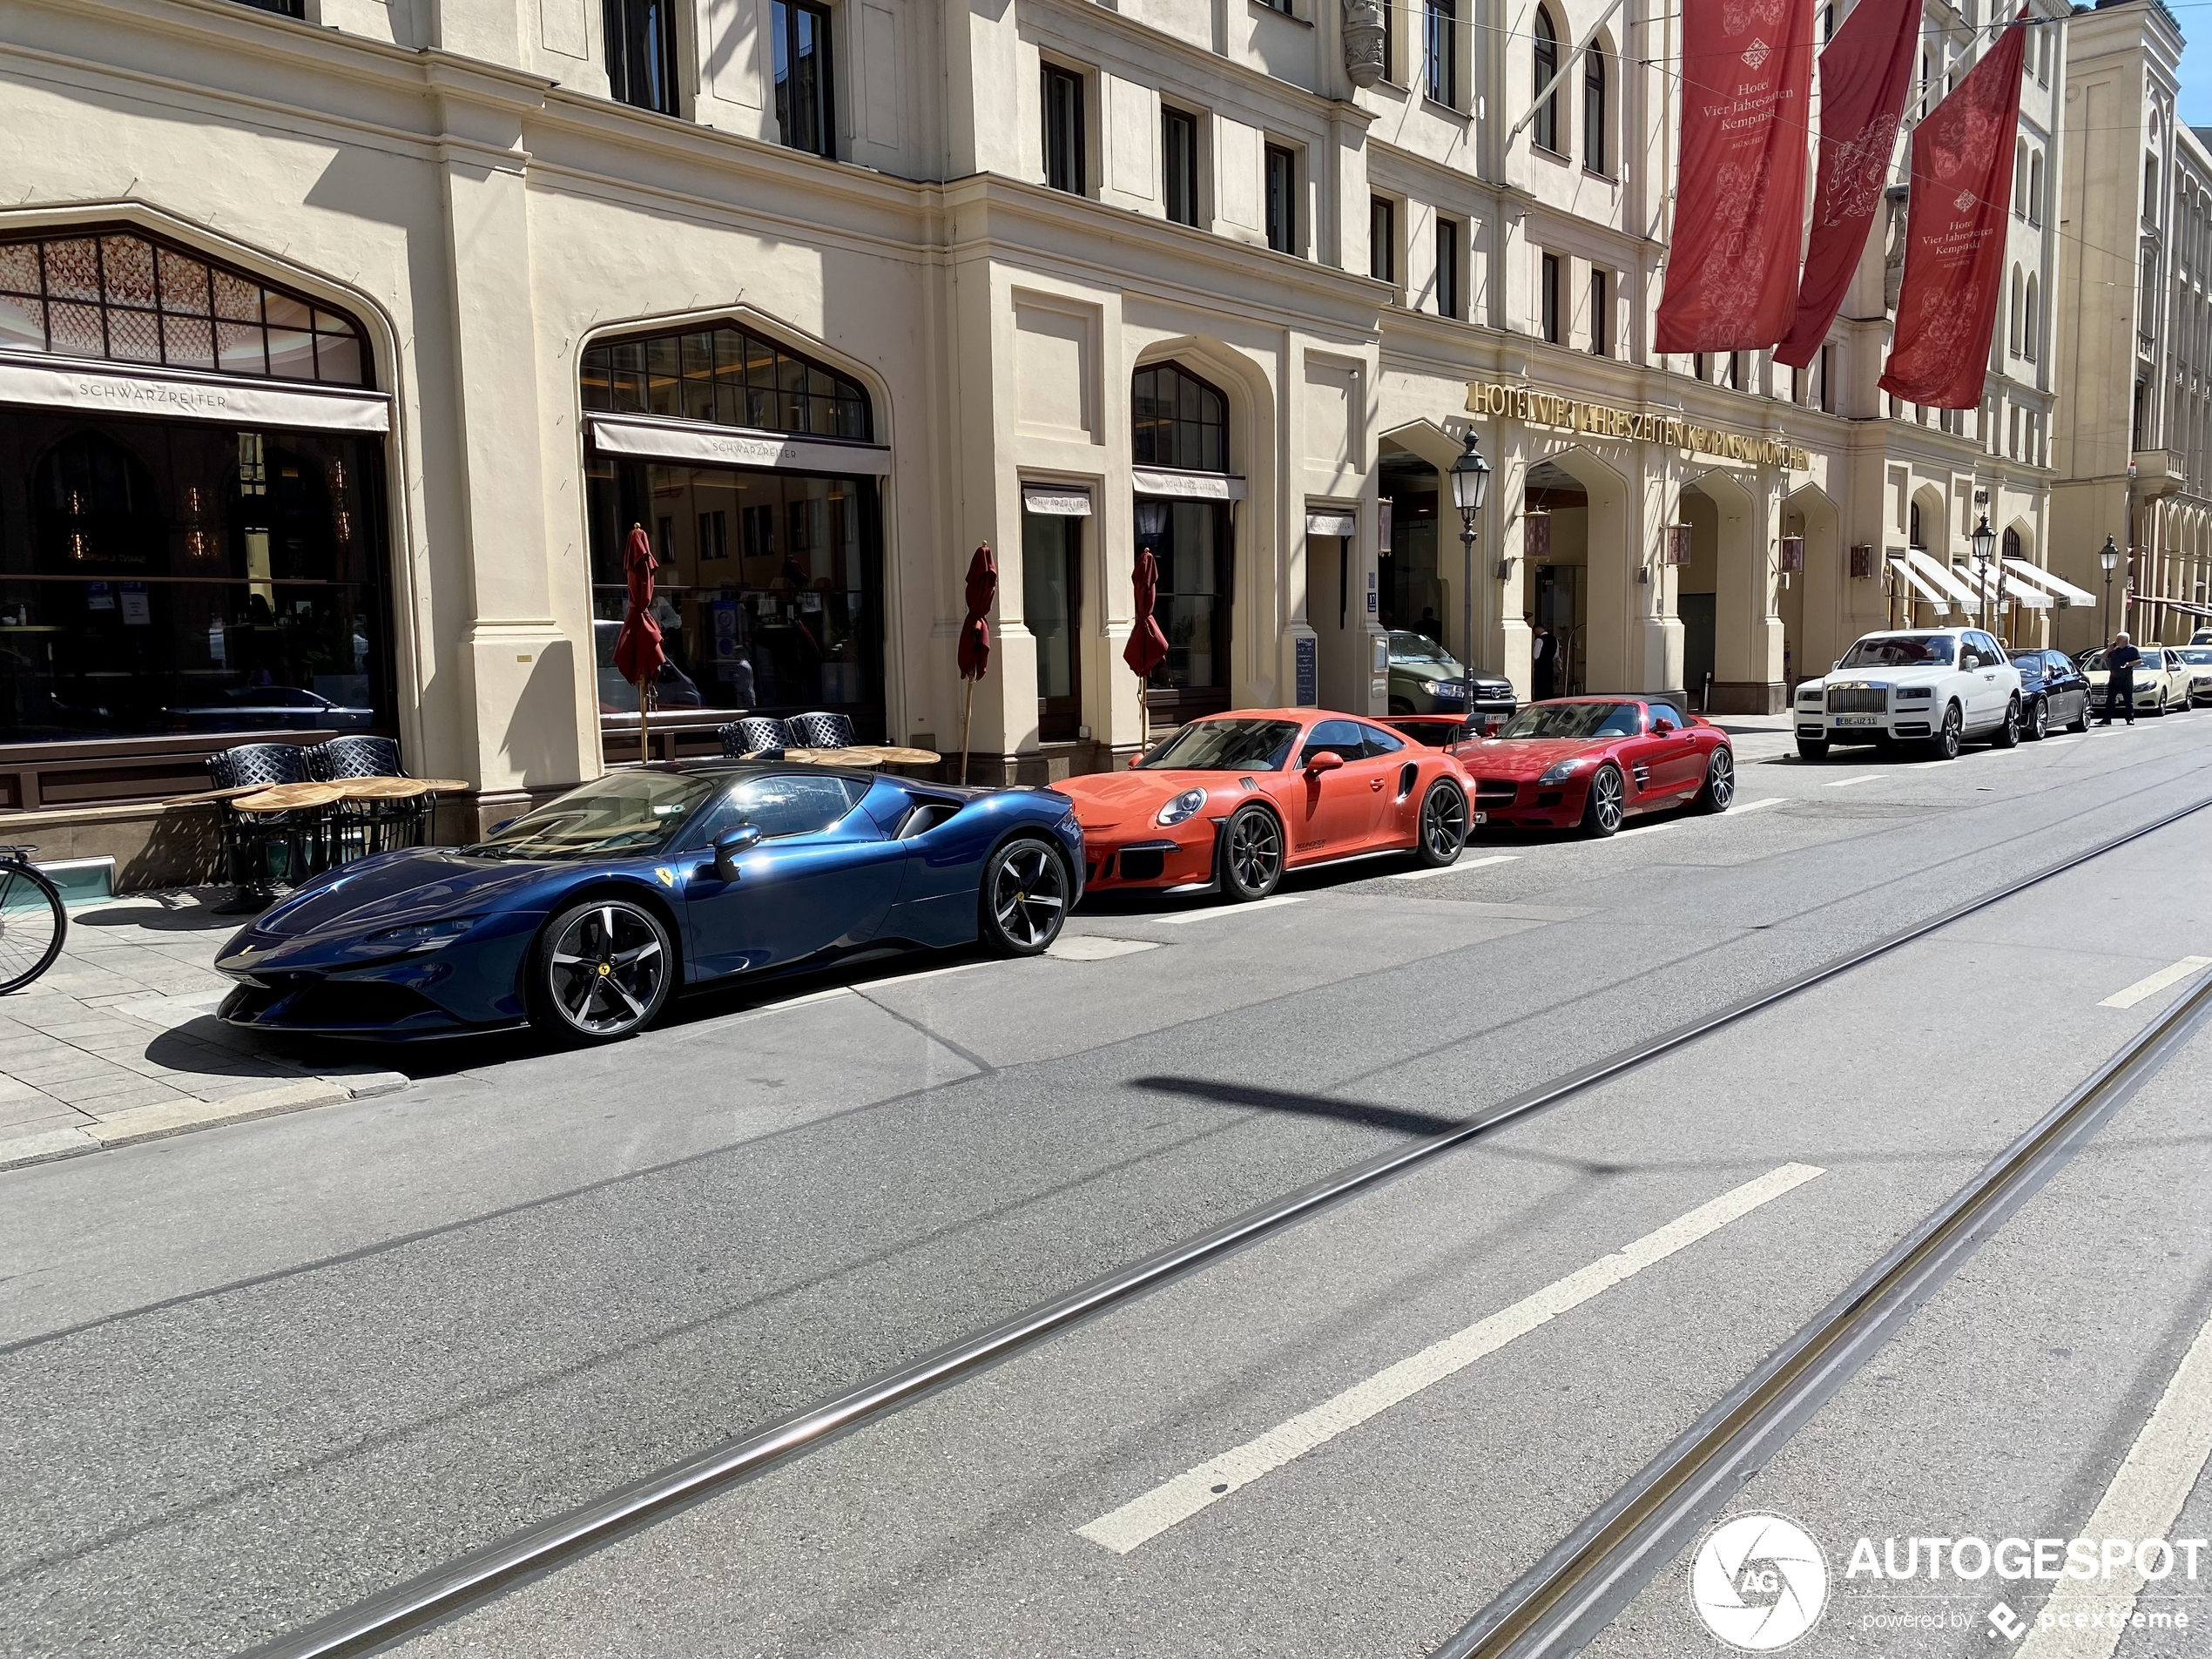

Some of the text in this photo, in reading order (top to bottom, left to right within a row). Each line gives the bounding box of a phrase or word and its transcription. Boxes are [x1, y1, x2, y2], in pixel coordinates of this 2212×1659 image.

[1738, 77, 1770, 96] Hotel
[1703, 105, 1730, 118] Vier
[1721, 105, 1776, 131] Kempinski
[1922, 235, 1943, 246] Vier
[79, 383, 226, 408] SCHWARZREITER
[1467, 383, 1537, 420] HOTEL
[1538, 395, 1575, 428] VIER
[1578, 401, 1683, 447] JAHRESZEITEN
[1686, 423, 1753, 461] KEMPINSKI
[712, 442, 796, 459] SCHWARZREITER
[1164, 480, 1216, 491] SCHWARZREITER
[1028, 497, 1089, 509] SCHWARZREITER
